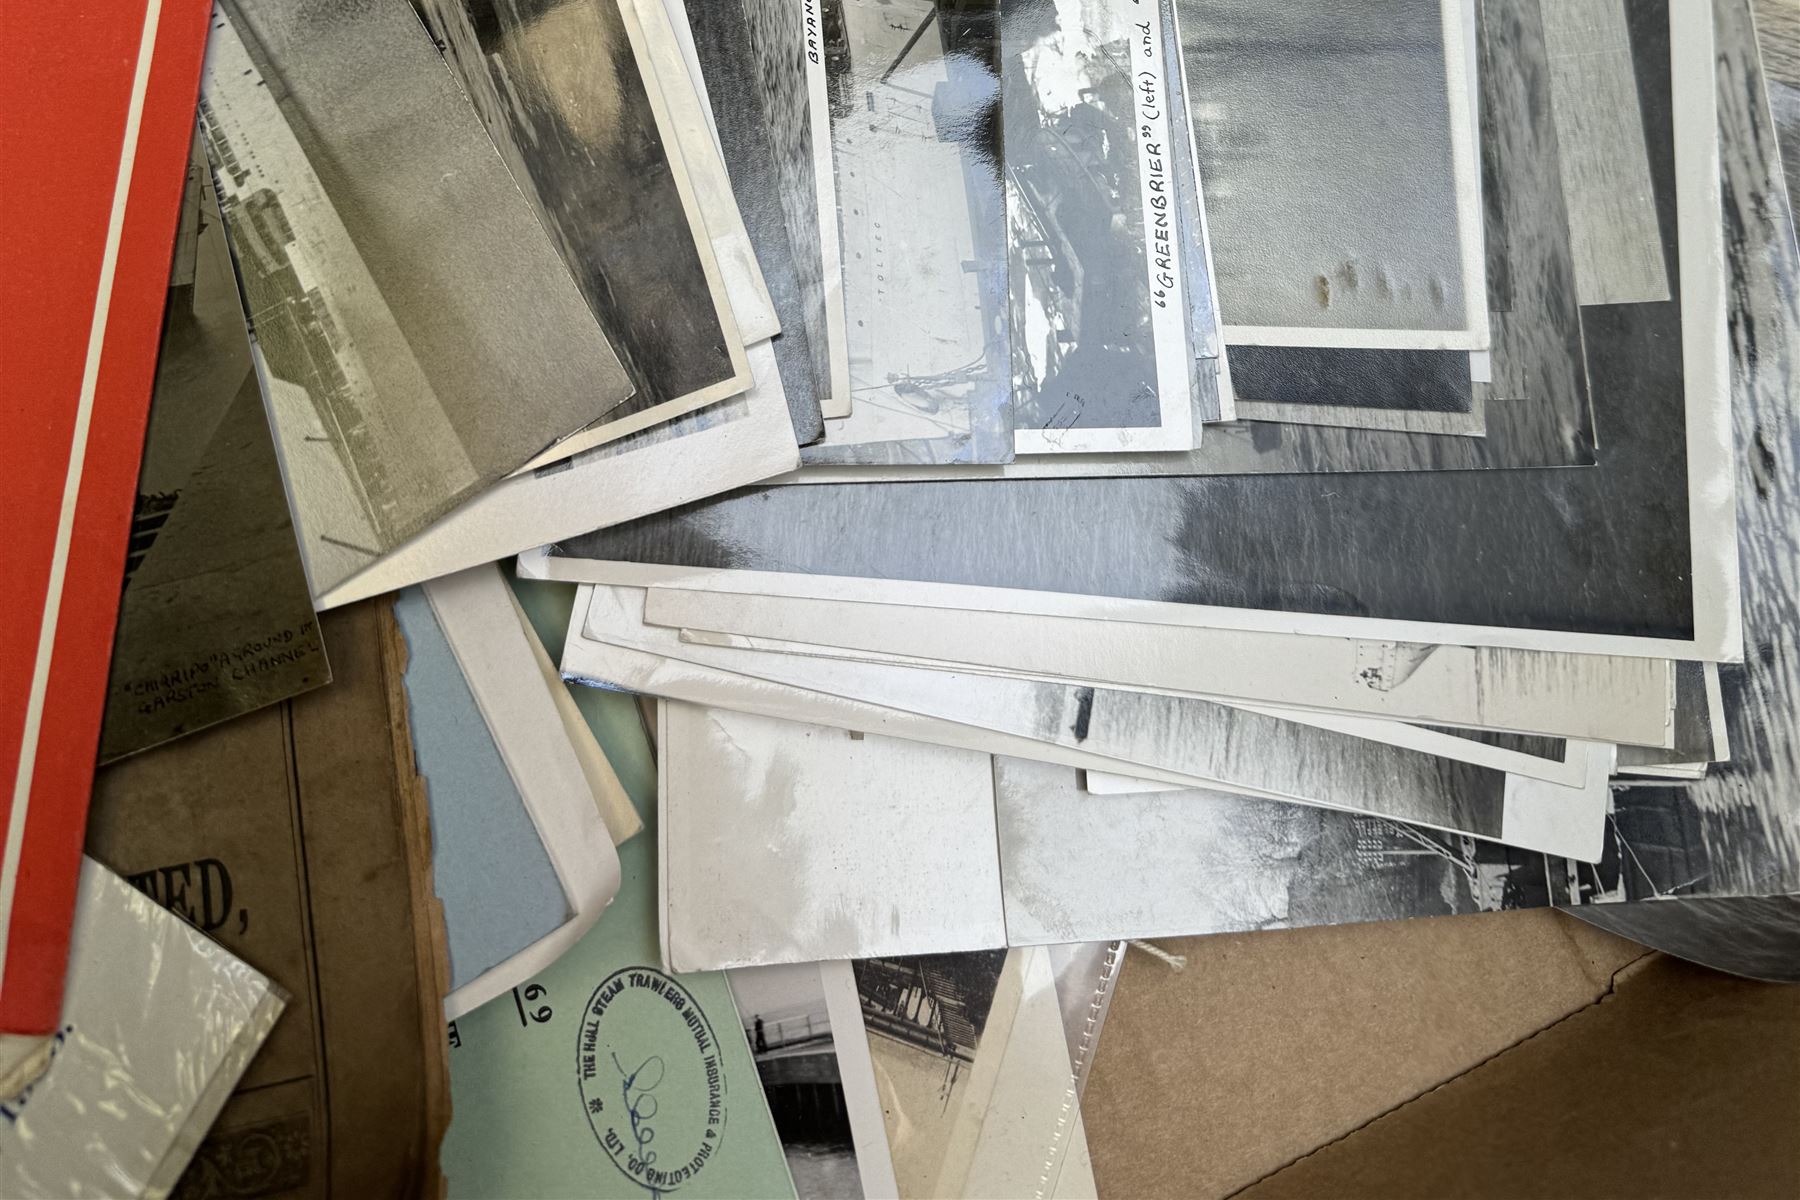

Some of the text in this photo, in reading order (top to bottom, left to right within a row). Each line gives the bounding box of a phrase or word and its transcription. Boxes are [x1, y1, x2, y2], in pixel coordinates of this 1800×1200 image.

[1136, 20, 1152, 58] and
[1138, 71, 1160, 120] (left)
[1142, 125, 1175, 309] "GREENBRIER"
[232, 645, 319, 681] CHANNEL
[592, 978, 625, 1016] STEAM
[628, 973, 685, 1011] TRAWLERS
[682, 1006, 711, 1054] MUTUAL
[583, 1055, 596, 1080] THE
[704, 1055, 722, 1125] INSURANCE
[646, 1142, 713, 1186] PROTECTING
